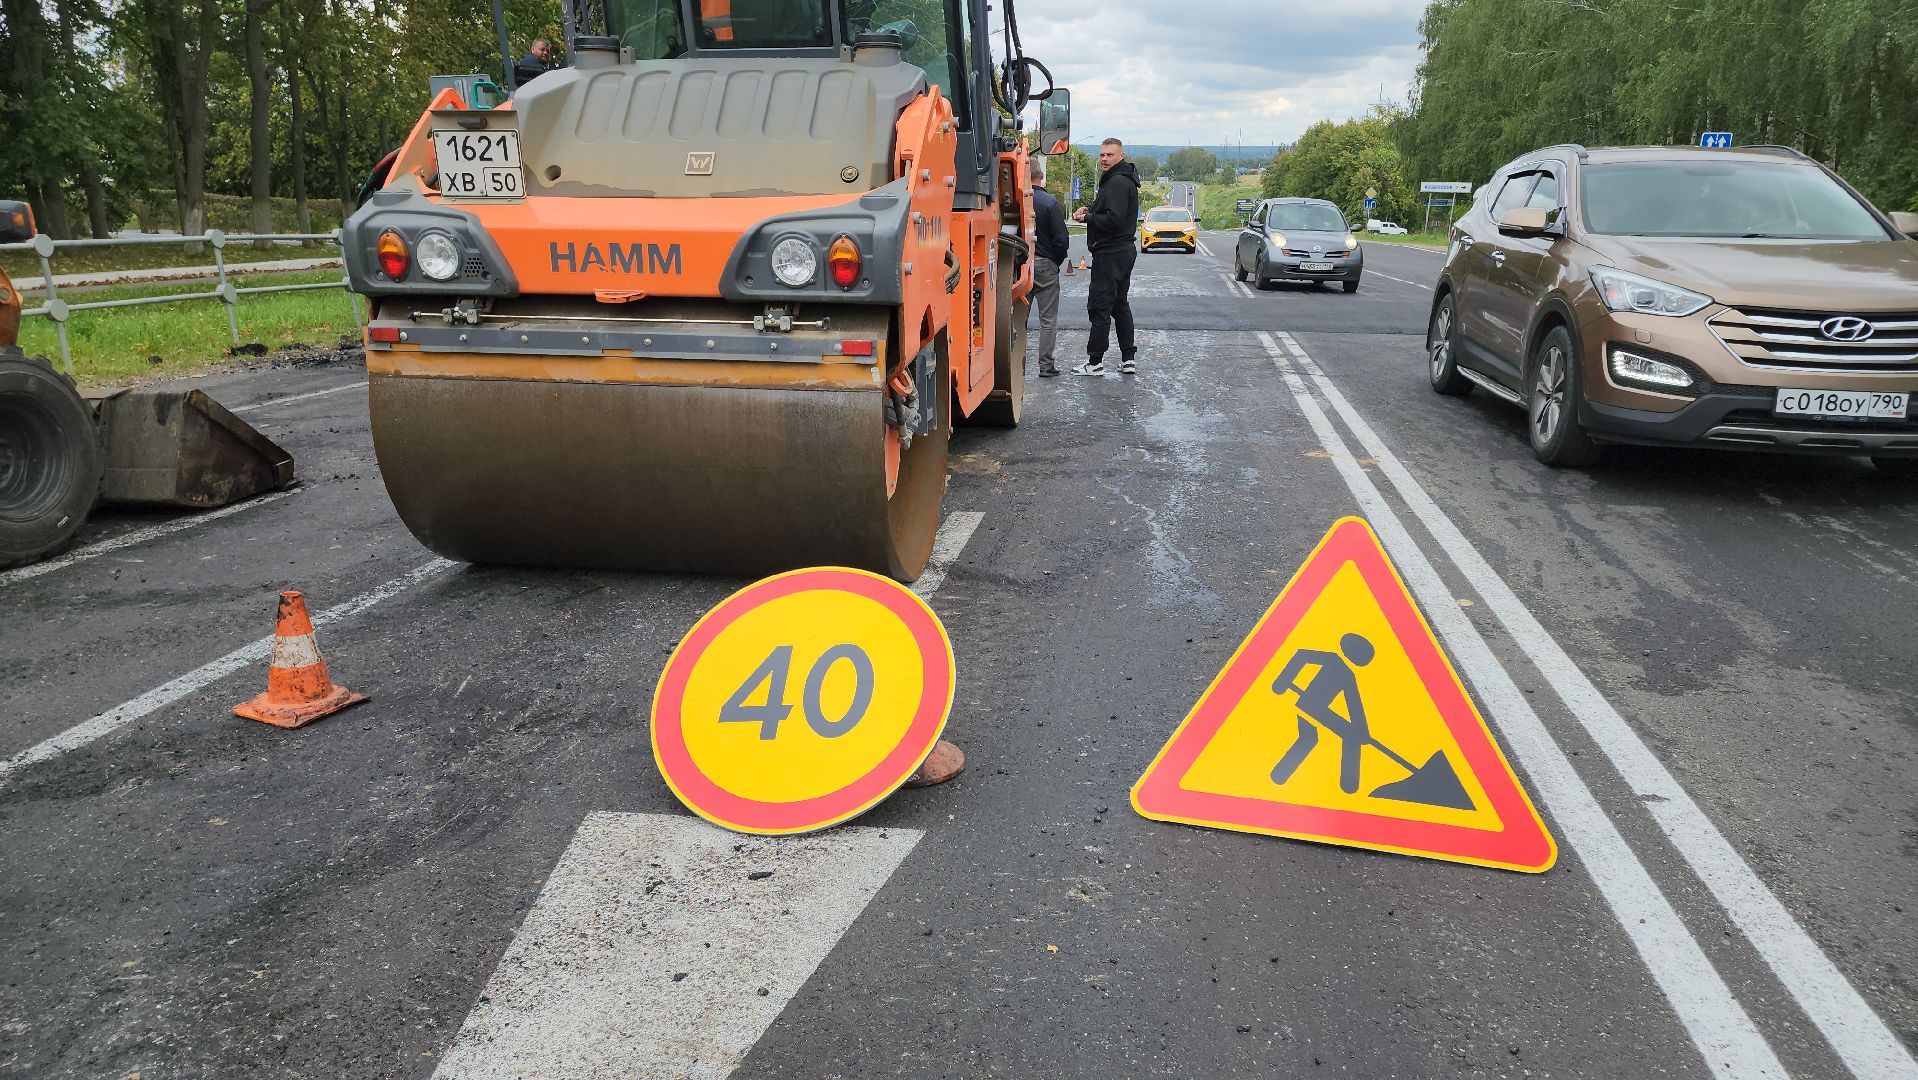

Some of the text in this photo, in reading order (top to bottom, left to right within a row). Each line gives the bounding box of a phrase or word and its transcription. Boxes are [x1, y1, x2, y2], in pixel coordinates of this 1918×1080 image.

[446, 135, 509, 162] 1621
[444, 172, 516, 192] ХВ 50
[548, 242, 683, 275] HAMM
[1872, 394, 1902, 409] 790
[718, 643, 875, 741] 40
